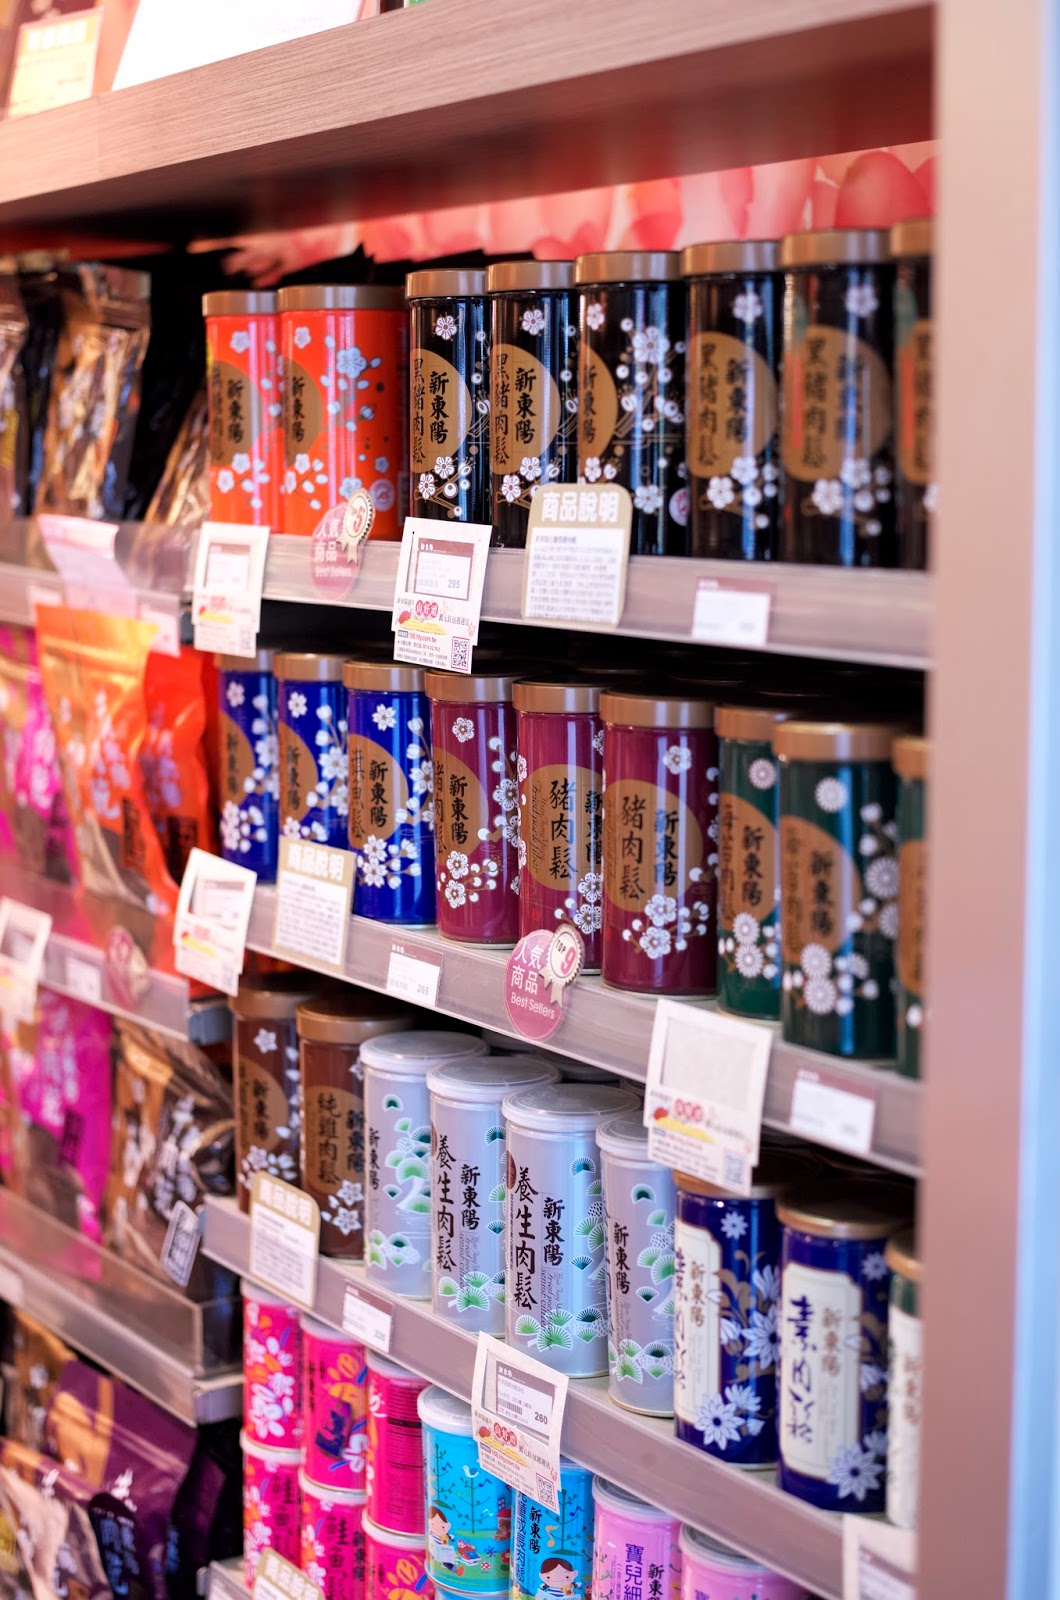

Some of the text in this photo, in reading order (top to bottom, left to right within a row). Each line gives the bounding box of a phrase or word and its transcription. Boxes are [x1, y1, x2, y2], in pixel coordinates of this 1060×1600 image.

[412, 356, 427, 466] 黑豬肉鬆
[429, 370, 450, 444] 新東陽
[494, 353, 510, 467] 黑豬肉鬆
[515, 367, 537, 445] 新東陽
[352, 505, 366, 533] 5
[541, 490, 620, 523] 商品說明
[447, 578, 461, 589] 295
[369, 760, 388, 828] 新東陽
[449, 774, 469, 845] 新東陽
[530, 814, 539, 841] pork
[549, 777, 578, 880] 豬肉鬆
[619, 794, 647, 900] 豬肉鬆
[653, 808, 679, 887] 新東陽
[555, 940, 567, 954] TOP
[560, 946, 576, 975] 9
[417, 984, 430, 995] 265
[511, 965, 538, 996] 商品
[511, 992, 555, 1019] Best Sellers
[369, 1127, 380, 1191] 新東陽
[436, 1134, 457, 1273] 養生肉鬆
[461, 1163, 481, 1231] 新東陽
[515, 1166, 539, 1311] 養生肉鬆
[543, 1196, 566, 1267] 新東陽
[613, 1221, 631, 1295] 新東陽
[534, 1411, 548, 1425] 260
[529, 1505, 543, 1555] 新東陽
[624, 1542, 644, 1600] 寶兒細
[648, 1563, 665, 1600] 新東
